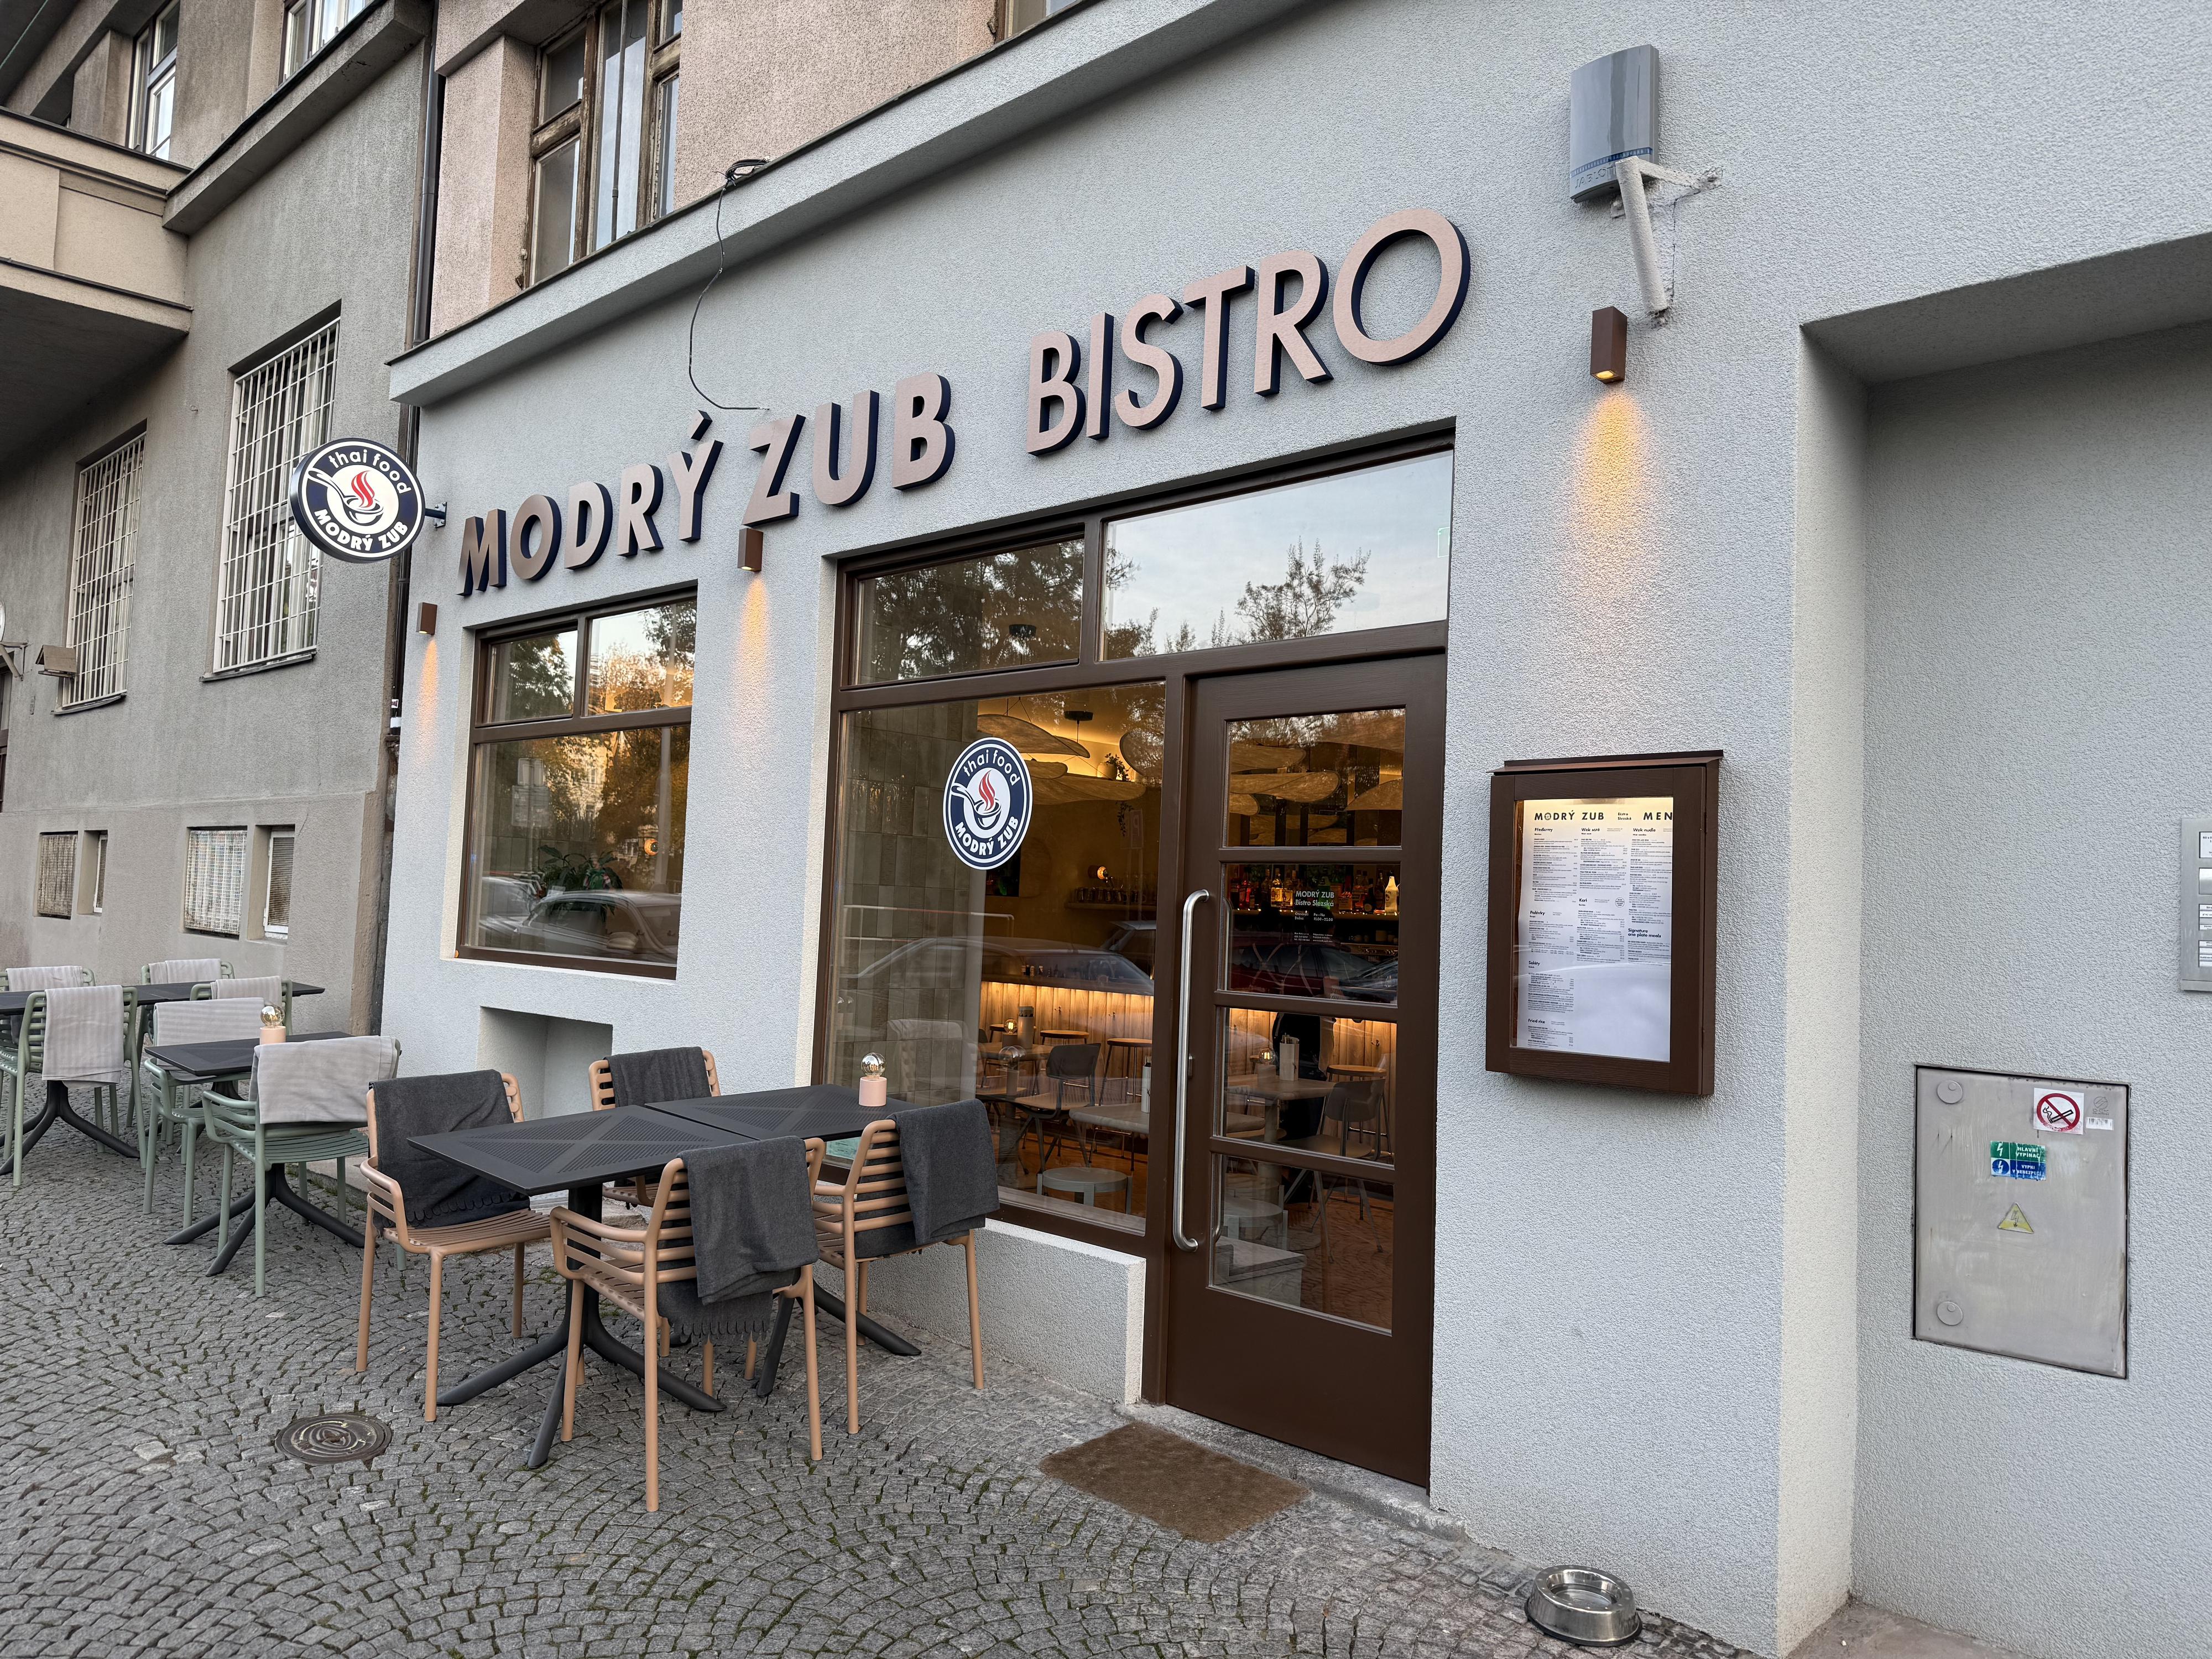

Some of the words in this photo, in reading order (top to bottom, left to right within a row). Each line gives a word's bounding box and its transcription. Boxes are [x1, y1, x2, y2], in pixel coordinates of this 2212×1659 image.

[457, 409, 723, 596] MODRÝ
[742, 372, 956, 526] ZUB
[1026, 208, 1470, 456] BISTRO
[328, 449, 368, 468] thai
[373, 453, 411, 494] food
[314, 509, 373, 551] MODRÝ
[378, 521, 408, 549] ZUB
[963, 749, 989, 777] thai
[993, 749, 1020, 786] food
[1535, 810, 1575, 820] MODRÝ
[1582, 812, 1604, 820] ZUB
[955, 821, 994, 855] MODRÝ
[997, 816, 1019, 849] ZUB
[1296, 889, 1319, 898] MODRÝ
